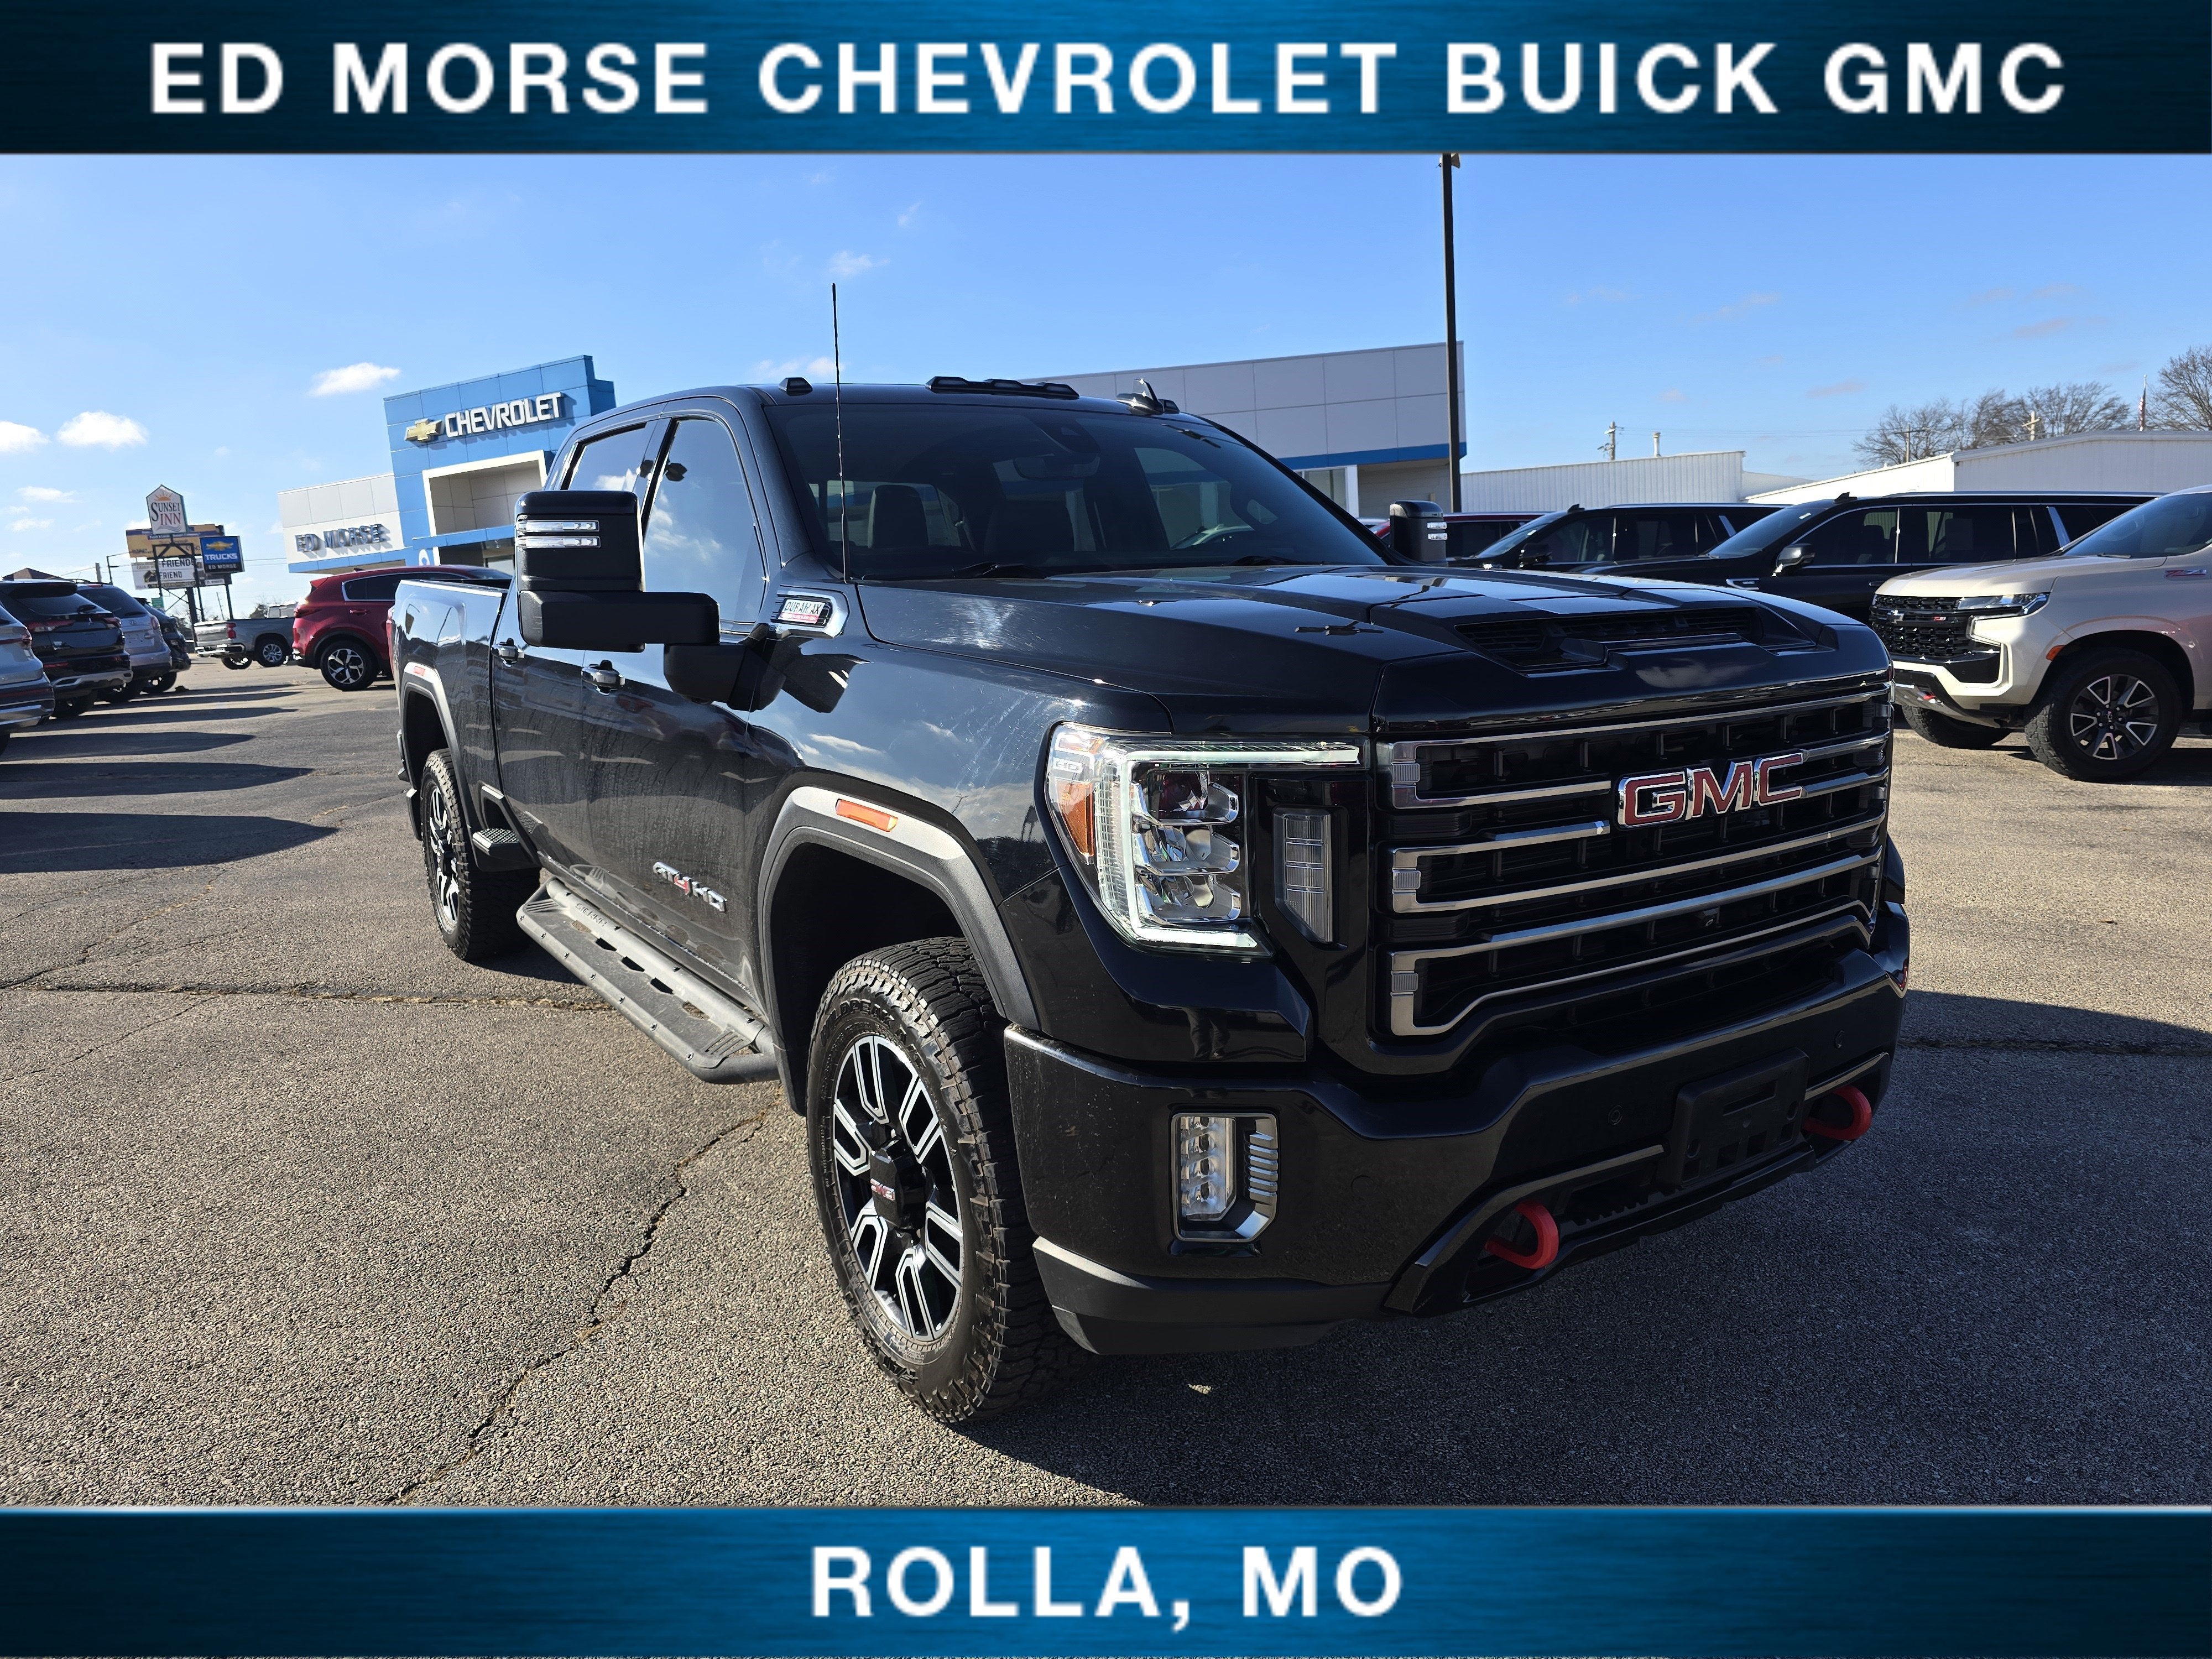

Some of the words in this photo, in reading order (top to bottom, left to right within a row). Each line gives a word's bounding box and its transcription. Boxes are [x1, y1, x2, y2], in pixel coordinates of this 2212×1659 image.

[445, 392, 564, 438] CHEVROLET
[150, 502, 180, 522] SUNSET
[160, 513, 181, 526] INN
[295, 534, 317, 552] ED
[324, 524, 382, 548] MORSE
[1618, 752, 1804, 828] GMC
